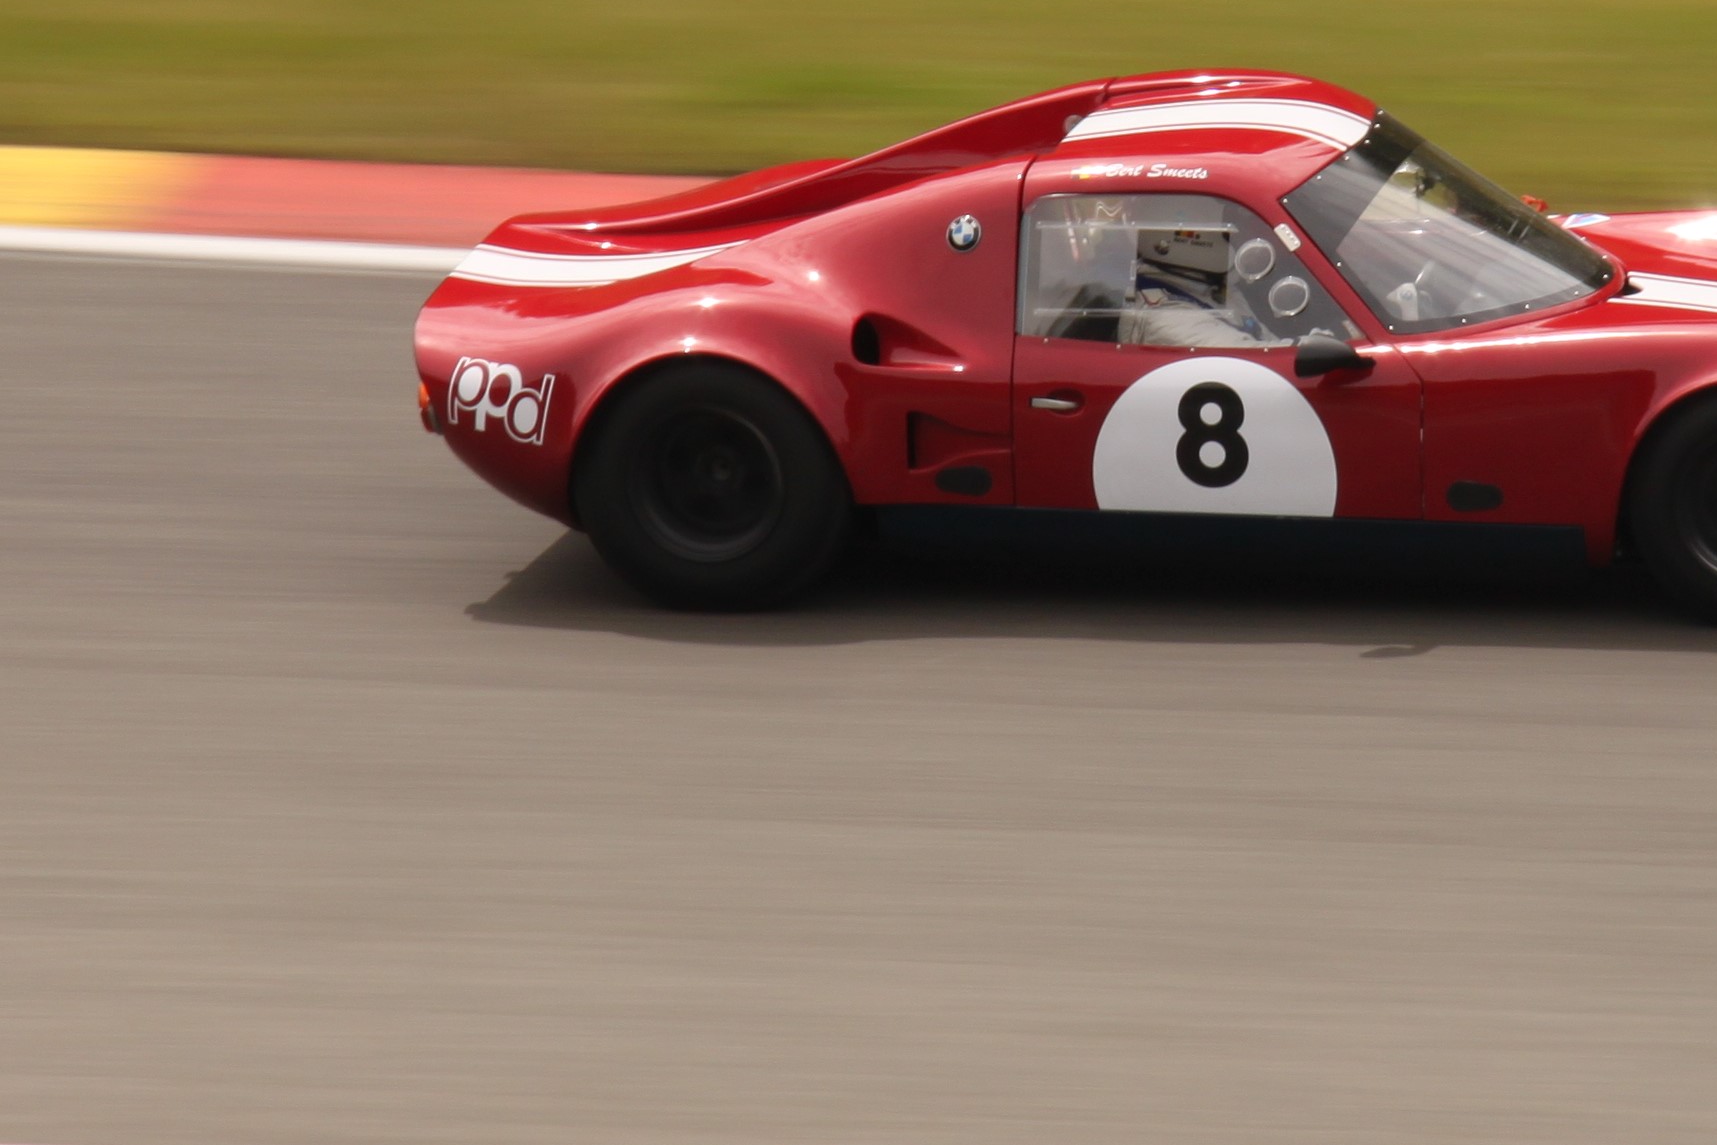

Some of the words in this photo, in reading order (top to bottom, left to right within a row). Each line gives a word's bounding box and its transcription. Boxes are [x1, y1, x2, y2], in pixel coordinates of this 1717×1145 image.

[1104, 163, 1144, 177] Bert
[1146, 163, 1208, 179] Smeets
[447, 356, 555, 445] ppd
[1176, 381, 1249, 488] 8
